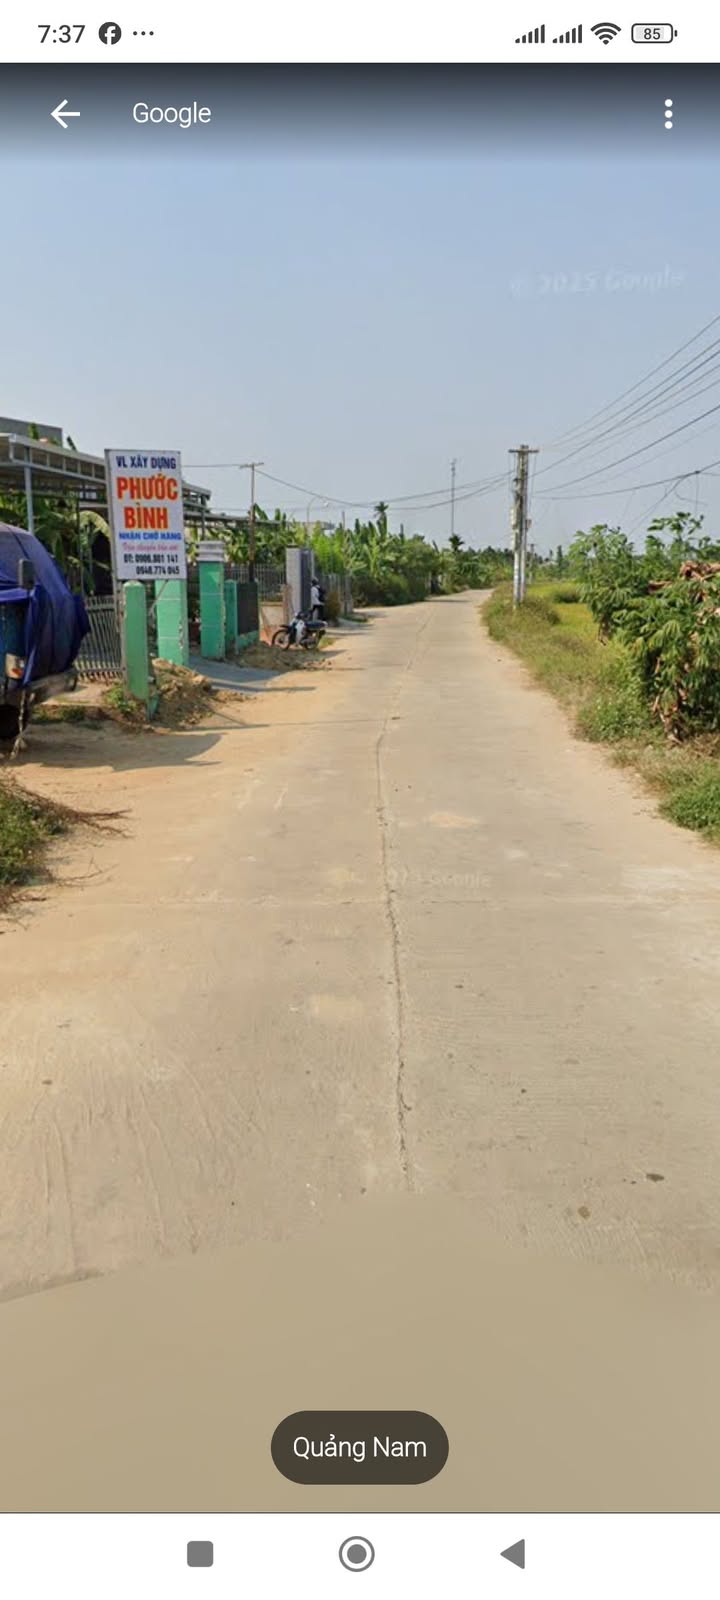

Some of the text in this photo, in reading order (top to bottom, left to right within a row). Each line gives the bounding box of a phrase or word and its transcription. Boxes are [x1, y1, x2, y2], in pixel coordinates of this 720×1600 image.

[116, 454, 177, 471] VL XÂY DỰNG
[116, 473, 178, 500] PHƯỚC
[124, 502, 169, 529] BÌNH
